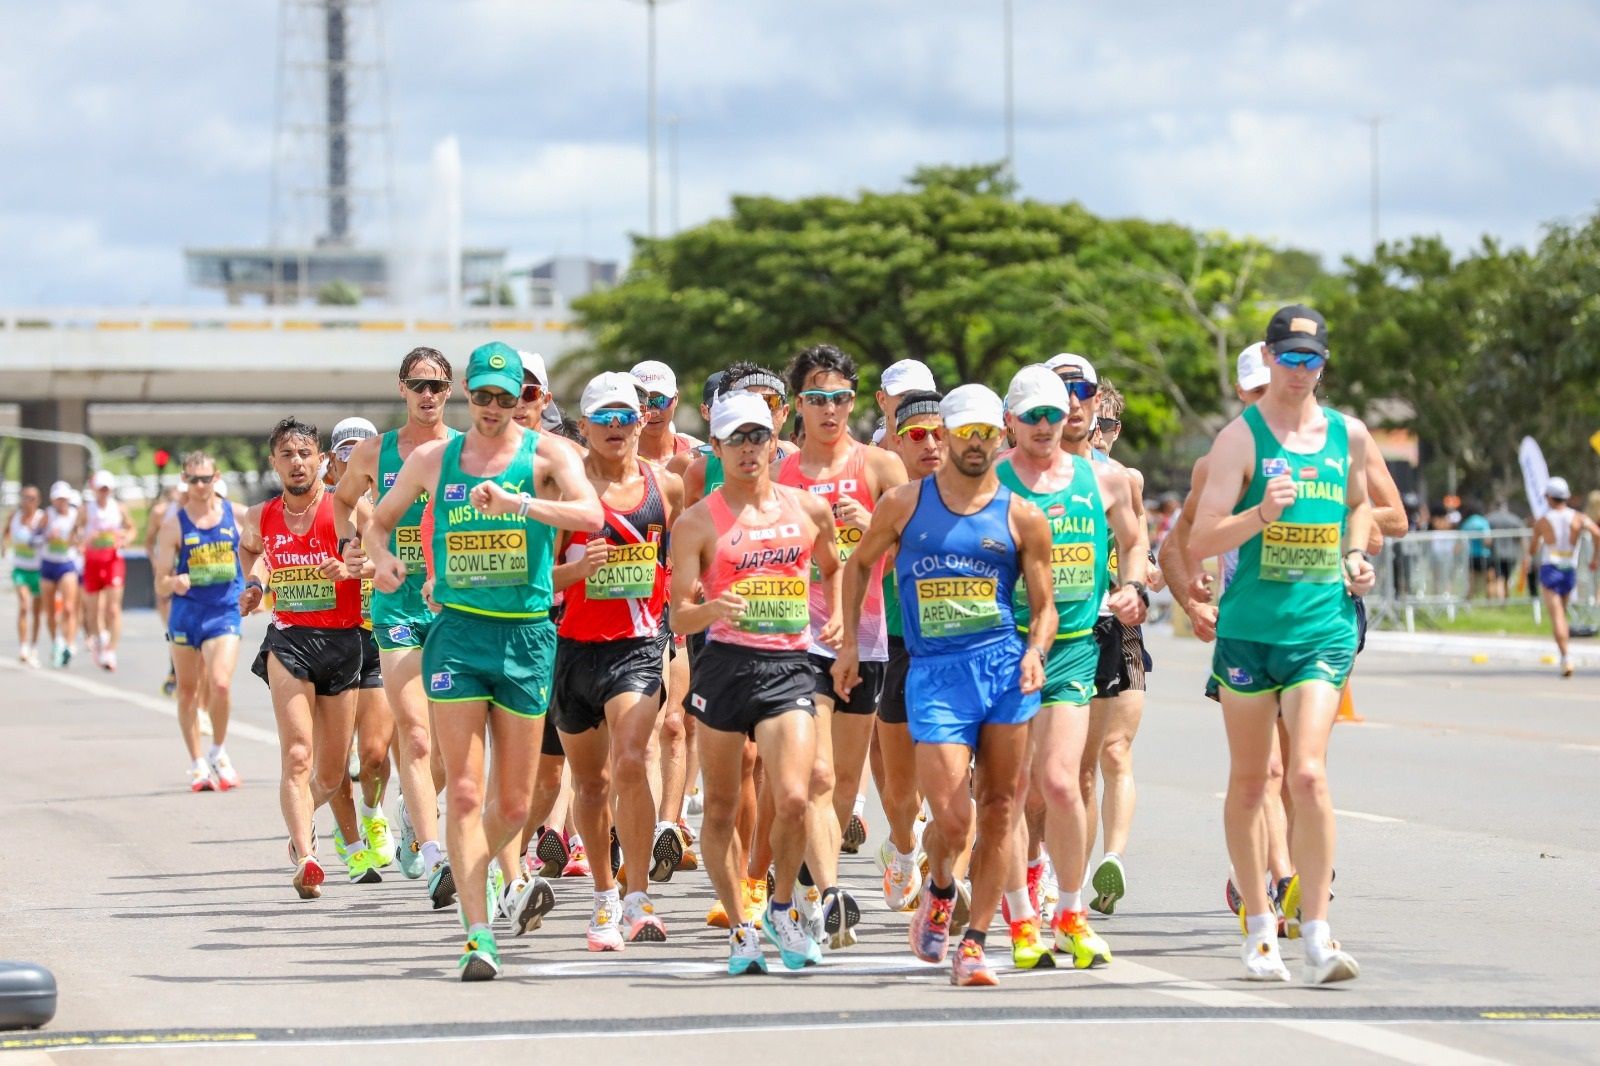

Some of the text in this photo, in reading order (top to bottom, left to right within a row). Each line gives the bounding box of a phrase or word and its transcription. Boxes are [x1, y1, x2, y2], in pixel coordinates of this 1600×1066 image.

[640, 373, 666, 383] CHINA
[1297, 480, 1344, 505] TRALIA
[1048, 516, 1095, 537] RALIA
[1265, 524, 1339, 544] SEIKO
[448, 533, 523, 551] SEIKO
[275, 551, 329, 565] TÜRKİYE
[448, 554, 526, 572] COWLEY 200
[607, 546, 655, 563] EIKO
[735, 547, 800, 570] JAPAN
[1265, 545, 1327, 566] THOMPSON
[912, 553, 1000, 579] COLOMBIA
[276, 584, 334, 600] RKMAZ 279
[735, 580, 805, 596] SEIKO
[919, 580, 994, 599] SEIKO
